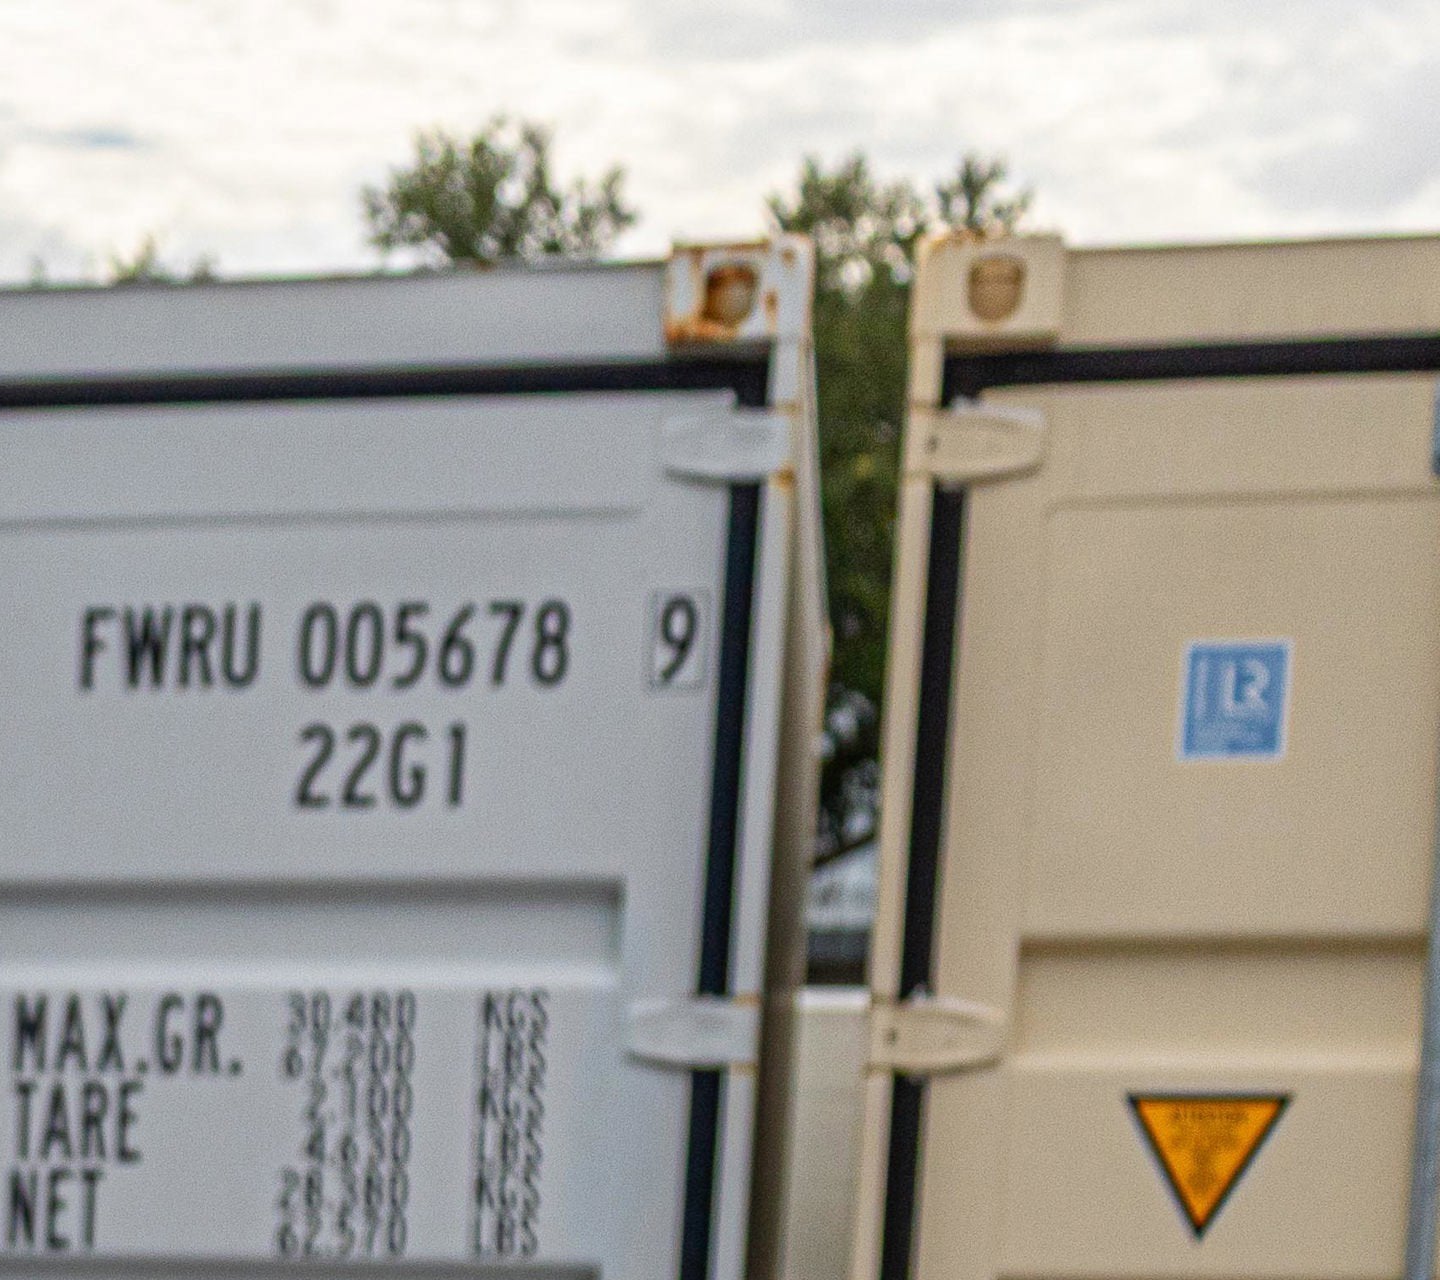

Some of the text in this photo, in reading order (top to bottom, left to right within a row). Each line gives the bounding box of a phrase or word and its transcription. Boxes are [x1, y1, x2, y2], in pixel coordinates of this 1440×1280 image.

[78, 596, 701, 690] FWRU 005678 9
[293, 721, 470, 808] 22G1
[11, 1081, 144, 1162] TARE
[7, 1168, 108, 1250] NET
